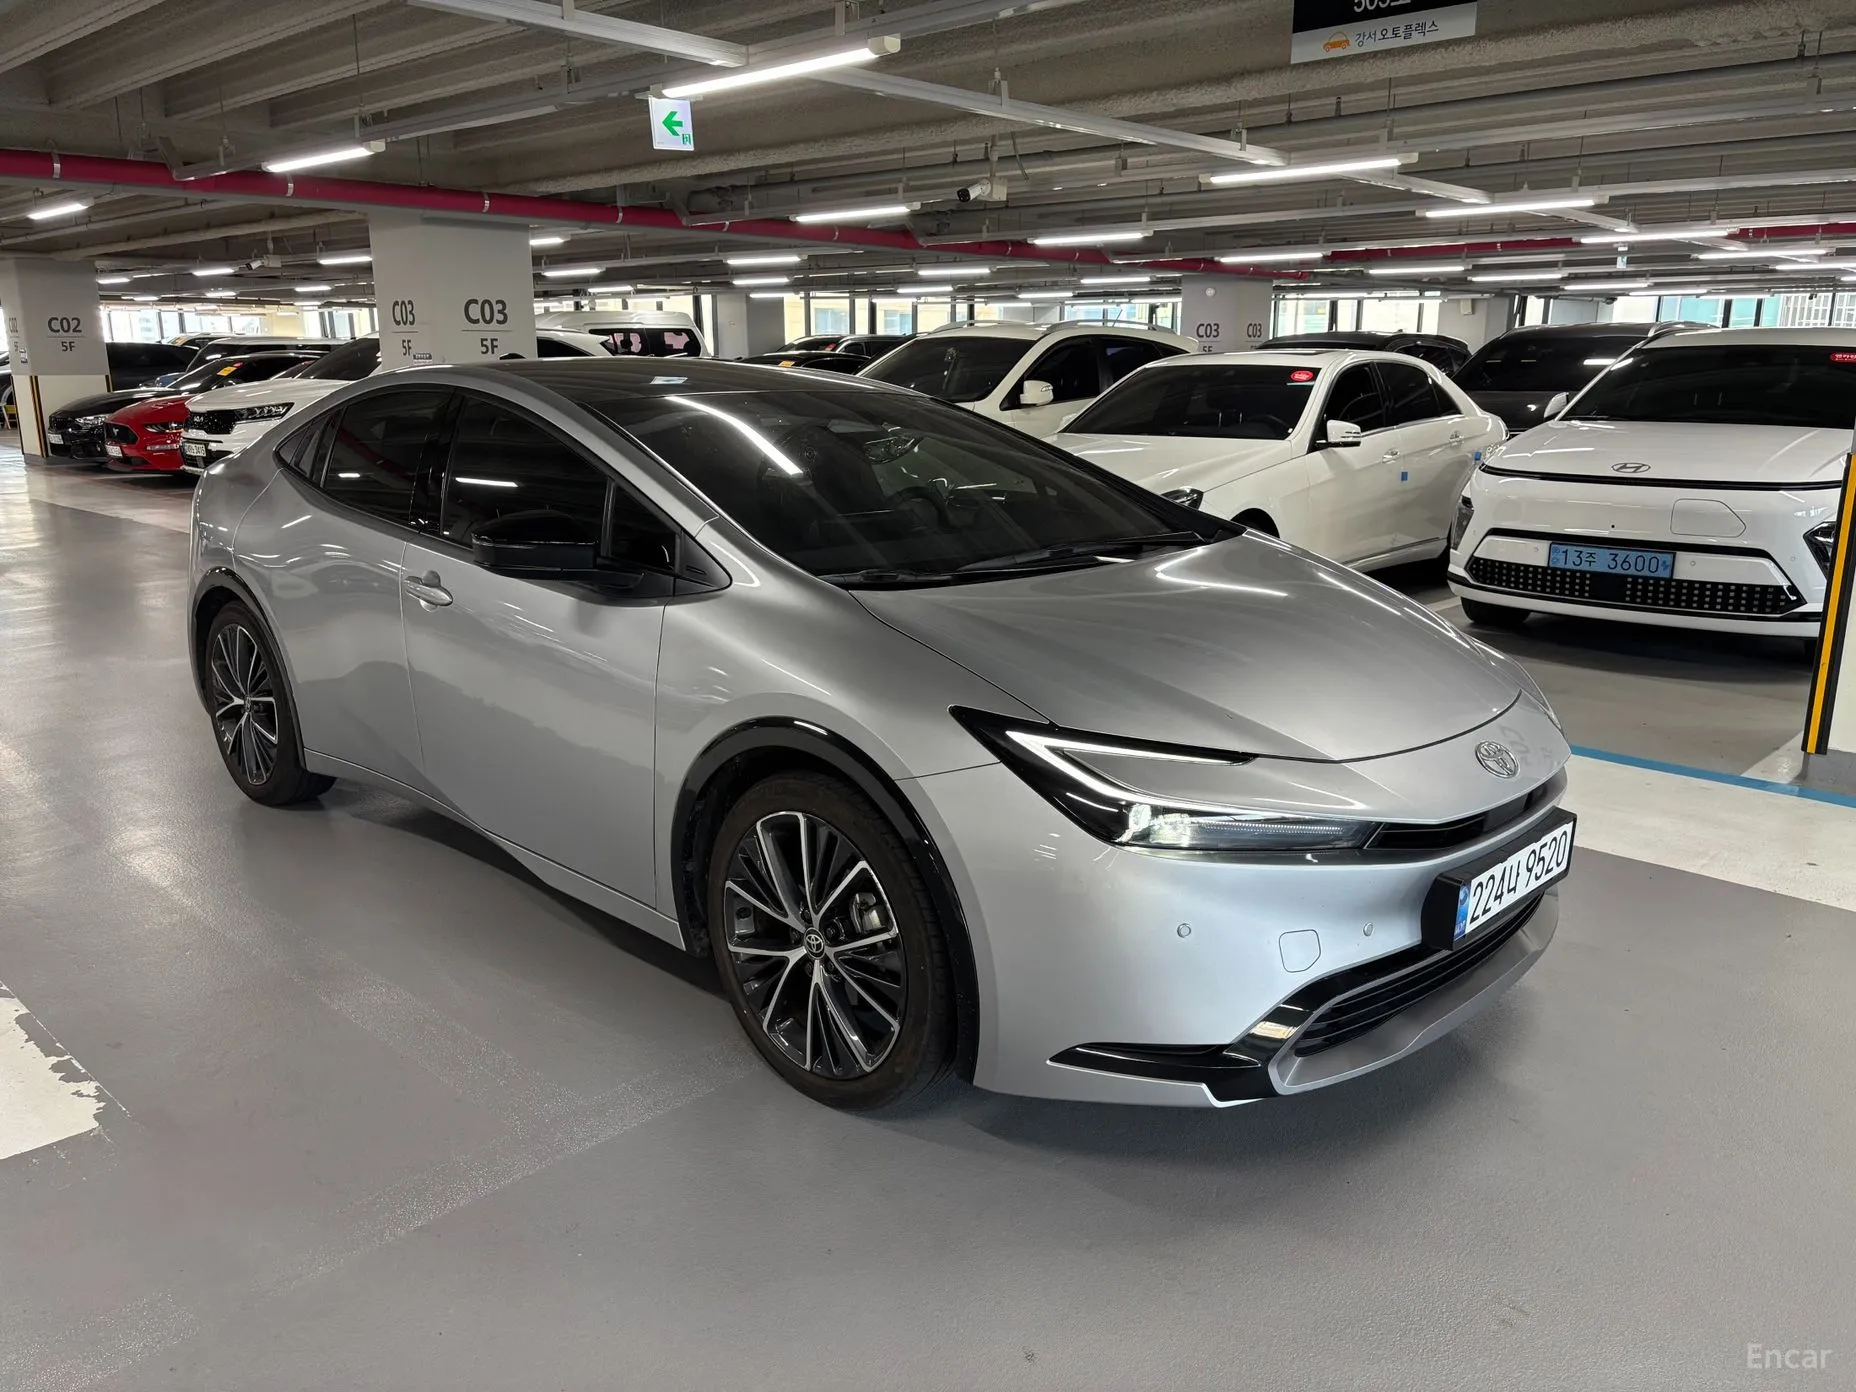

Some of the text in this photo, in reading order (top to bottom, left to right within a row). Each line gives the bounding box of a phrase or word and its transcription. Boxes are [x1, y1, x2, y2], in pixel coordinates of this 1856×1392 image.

[392, 300, 416, 326] C03
[463, 298, 508, 325] C03
[47, 316, 82, 333] C02
[1196, 323, 1220, 338] C03
[1246, 323, 1262, 338] C03
[61, 341, 76, 352] 5F
[401, 339, 412, 356] 5F
[480, 338, 499, 354] 5F
[1561, 549, 1597, 567] 13주
[1607, 552, 1660, 574] 3600
[1525, 830, 1569, 888] 9520
